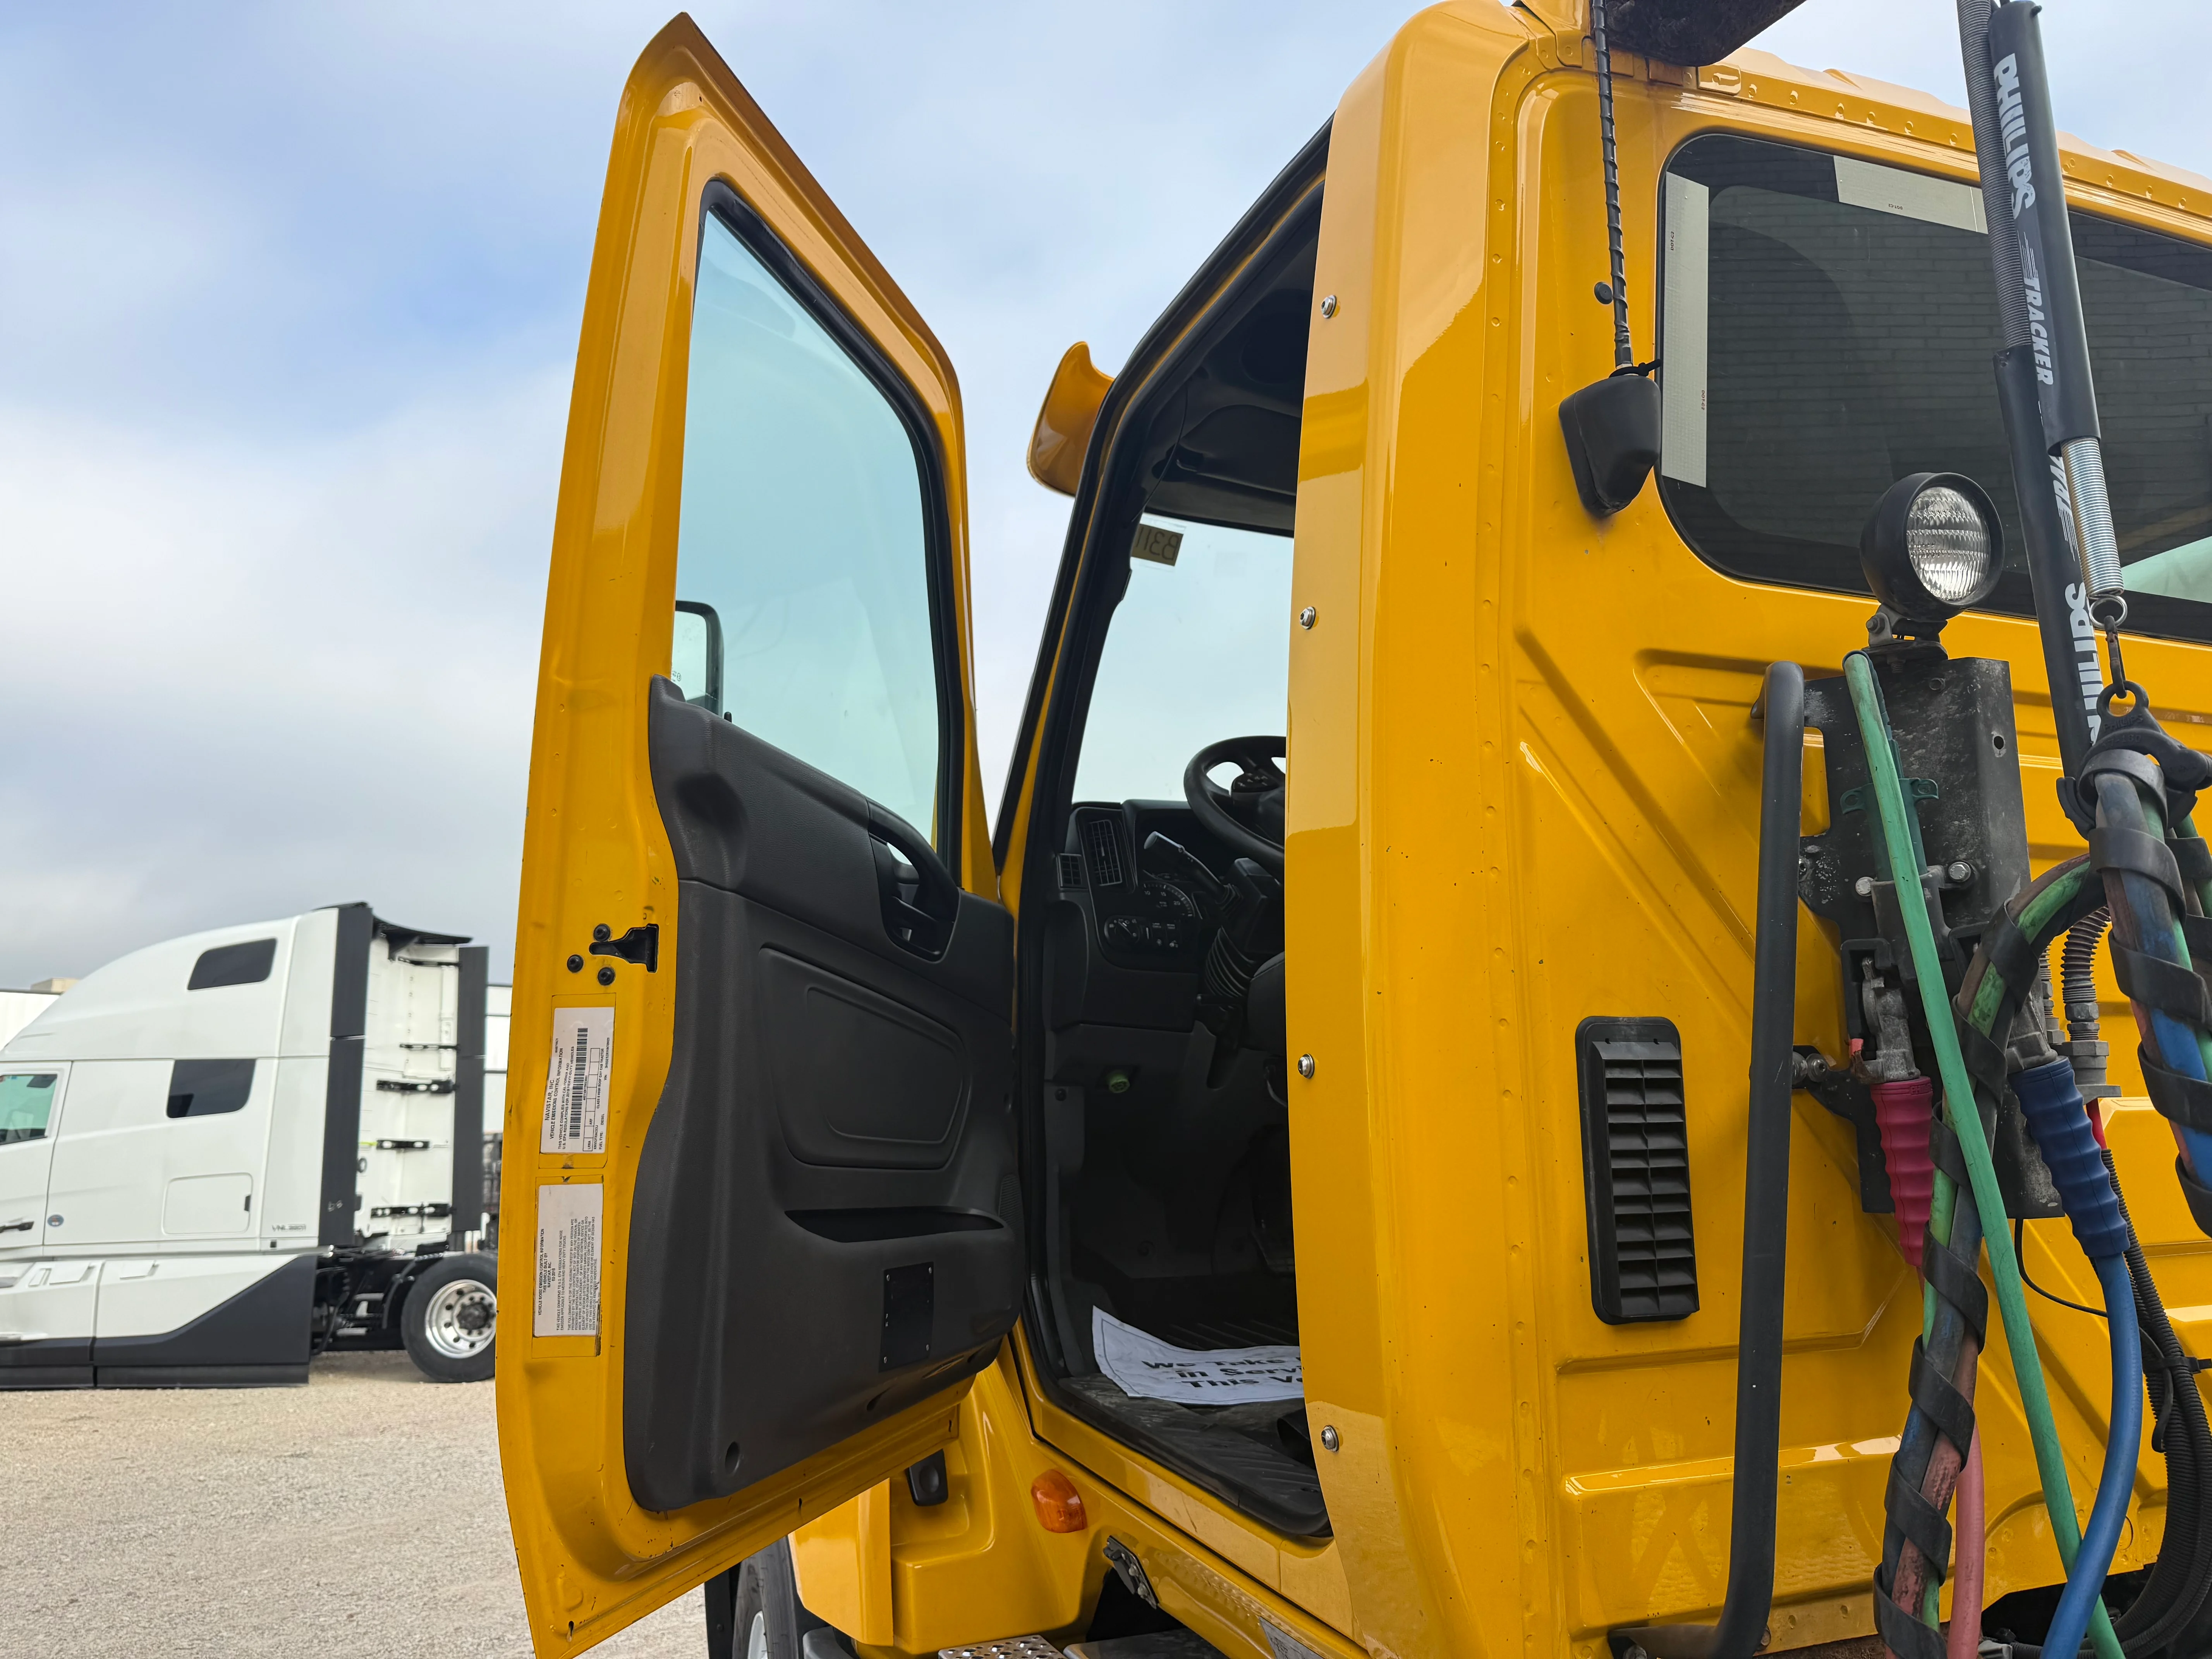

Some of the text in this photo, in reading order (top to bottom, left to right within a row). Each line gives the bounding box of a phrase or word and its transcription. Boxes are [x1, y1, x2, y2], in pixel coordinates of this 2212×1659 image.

[1994, 53, 2054, 385] PHILLIPS TRACKER
[1181, 1378, 1260, 1388] This
